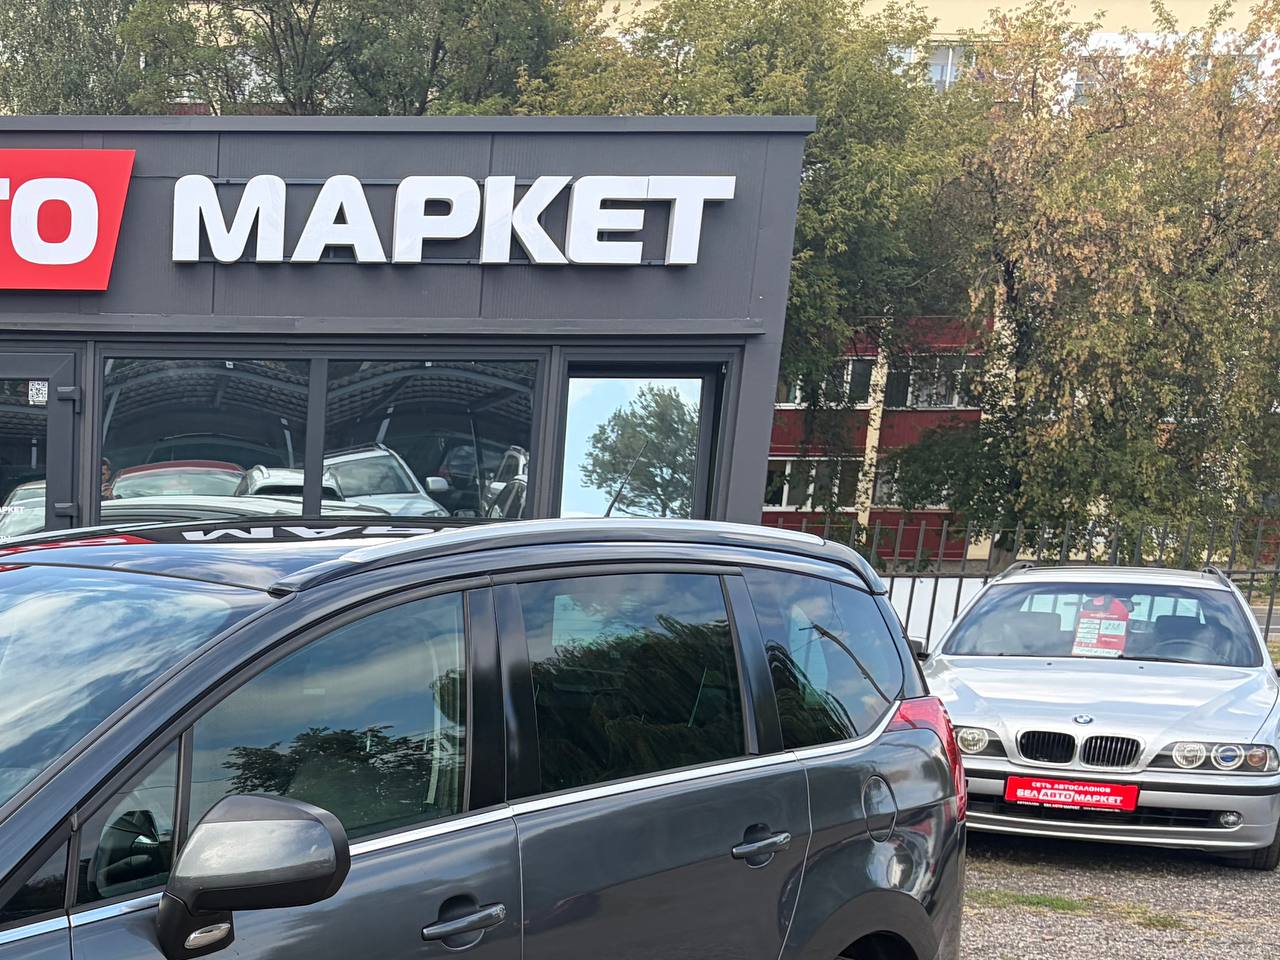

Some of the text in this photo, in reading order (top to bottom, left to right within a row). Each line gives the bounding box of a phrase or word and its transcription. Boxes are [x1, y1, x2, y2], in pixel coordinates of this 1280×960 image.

[172, 174, 736, 265] МАРКЕТ
[1031, 781, 1111, 793] СЕТЬ АВТОСАЛОНОВ
[1016, 788, 1124, 804] БЕЛ АВТО МАРКЕТ
